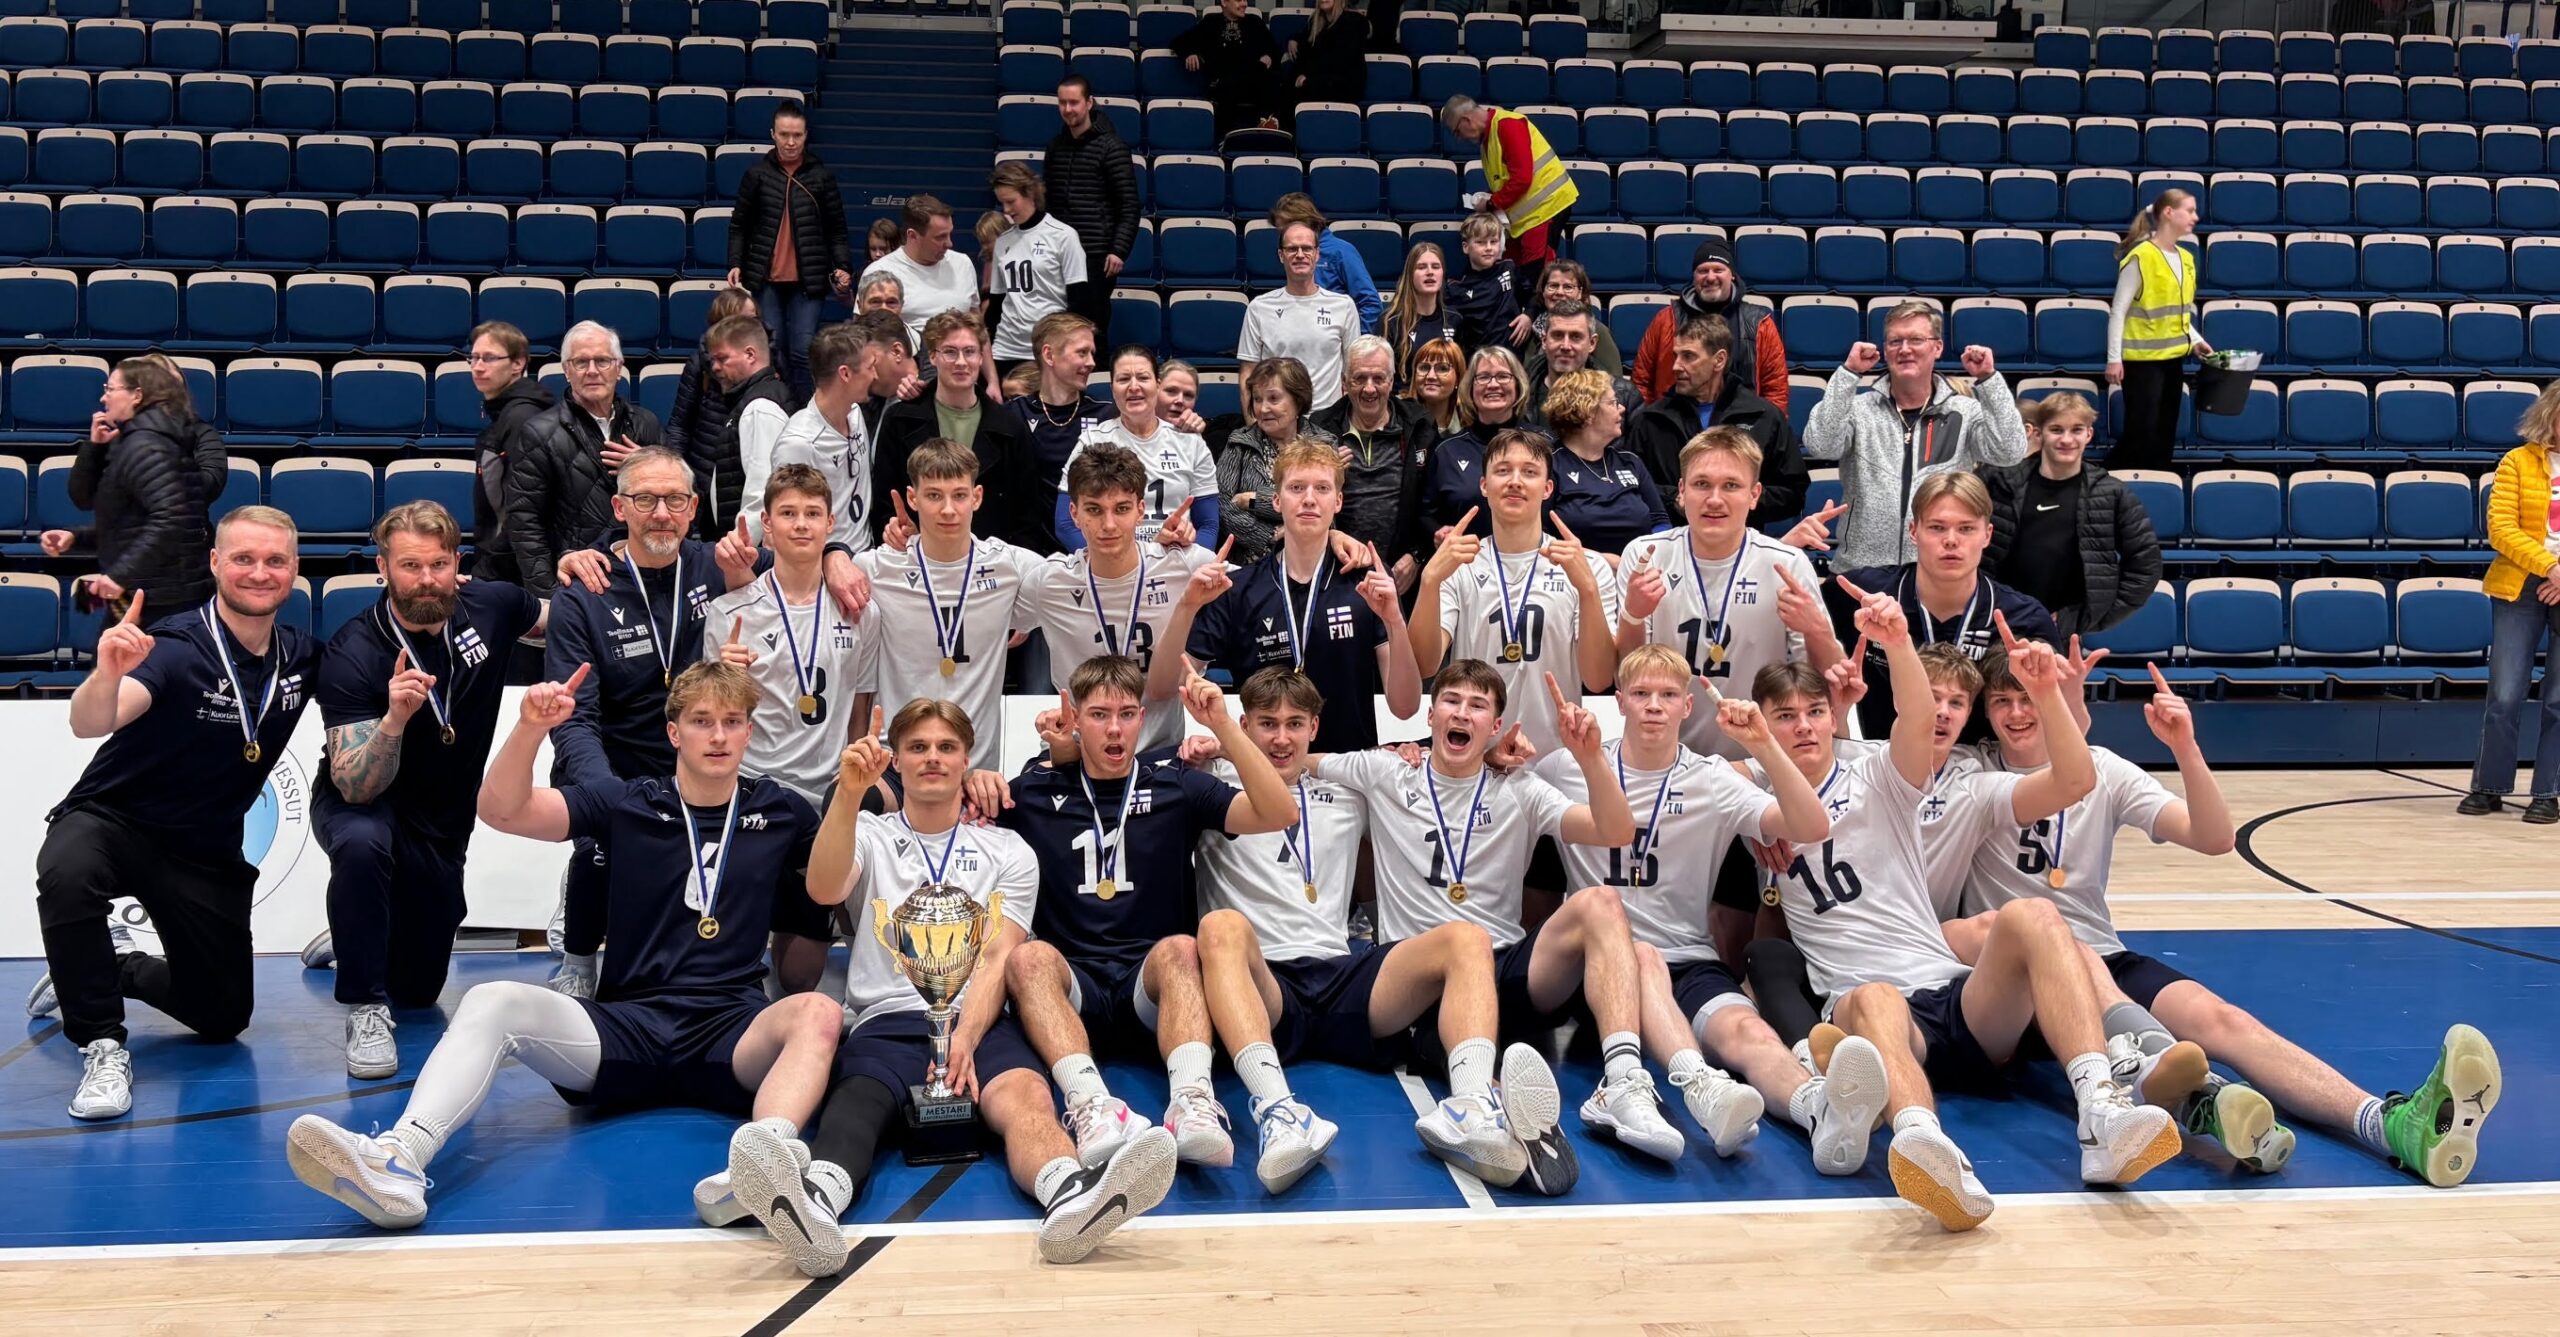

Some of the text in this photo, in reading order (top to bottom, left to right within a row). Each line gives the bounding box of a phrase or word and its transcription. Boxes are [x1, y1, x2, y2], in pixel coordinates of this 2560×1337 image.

[872, 195, 908, 206] ela
[1005, 260, 1033, 292] 10
[1317, 316, 1331, 325] FIN
[1161, 461, 1180, 470] FIN
[1144, 479, 1168, 520] 1
[976, 579, 997, 591] FIN
[1543, 581, 1564, 592] FIN
[1147, 591, 1169, 606] FIN
[1735, 592, 1756, 604] FIN
[1329, 622, 1354, 640] FIN
[1489, 604, 1545, 664] 10
[834, 636, 853, 649] FIN
[1677, 618, 1731, 678] 12
[462, 642, 488, 668] FIN
[282, 692, 302, 711] FIN
[1129, 802, 1151, 815] FIN
[742, 818, 768, 830] FIN
[1473, 812, 1491, 826] IN
[2016, 818, 2050, 874] 5
[1072, 827, 1134, 894] 11
[1603, 828, 1658, 887] 15
[955, 859, 978, 871] FIN
[1787, 838, 1862, 915] 16
[926, 1105, 967, 1116] MESTARI
